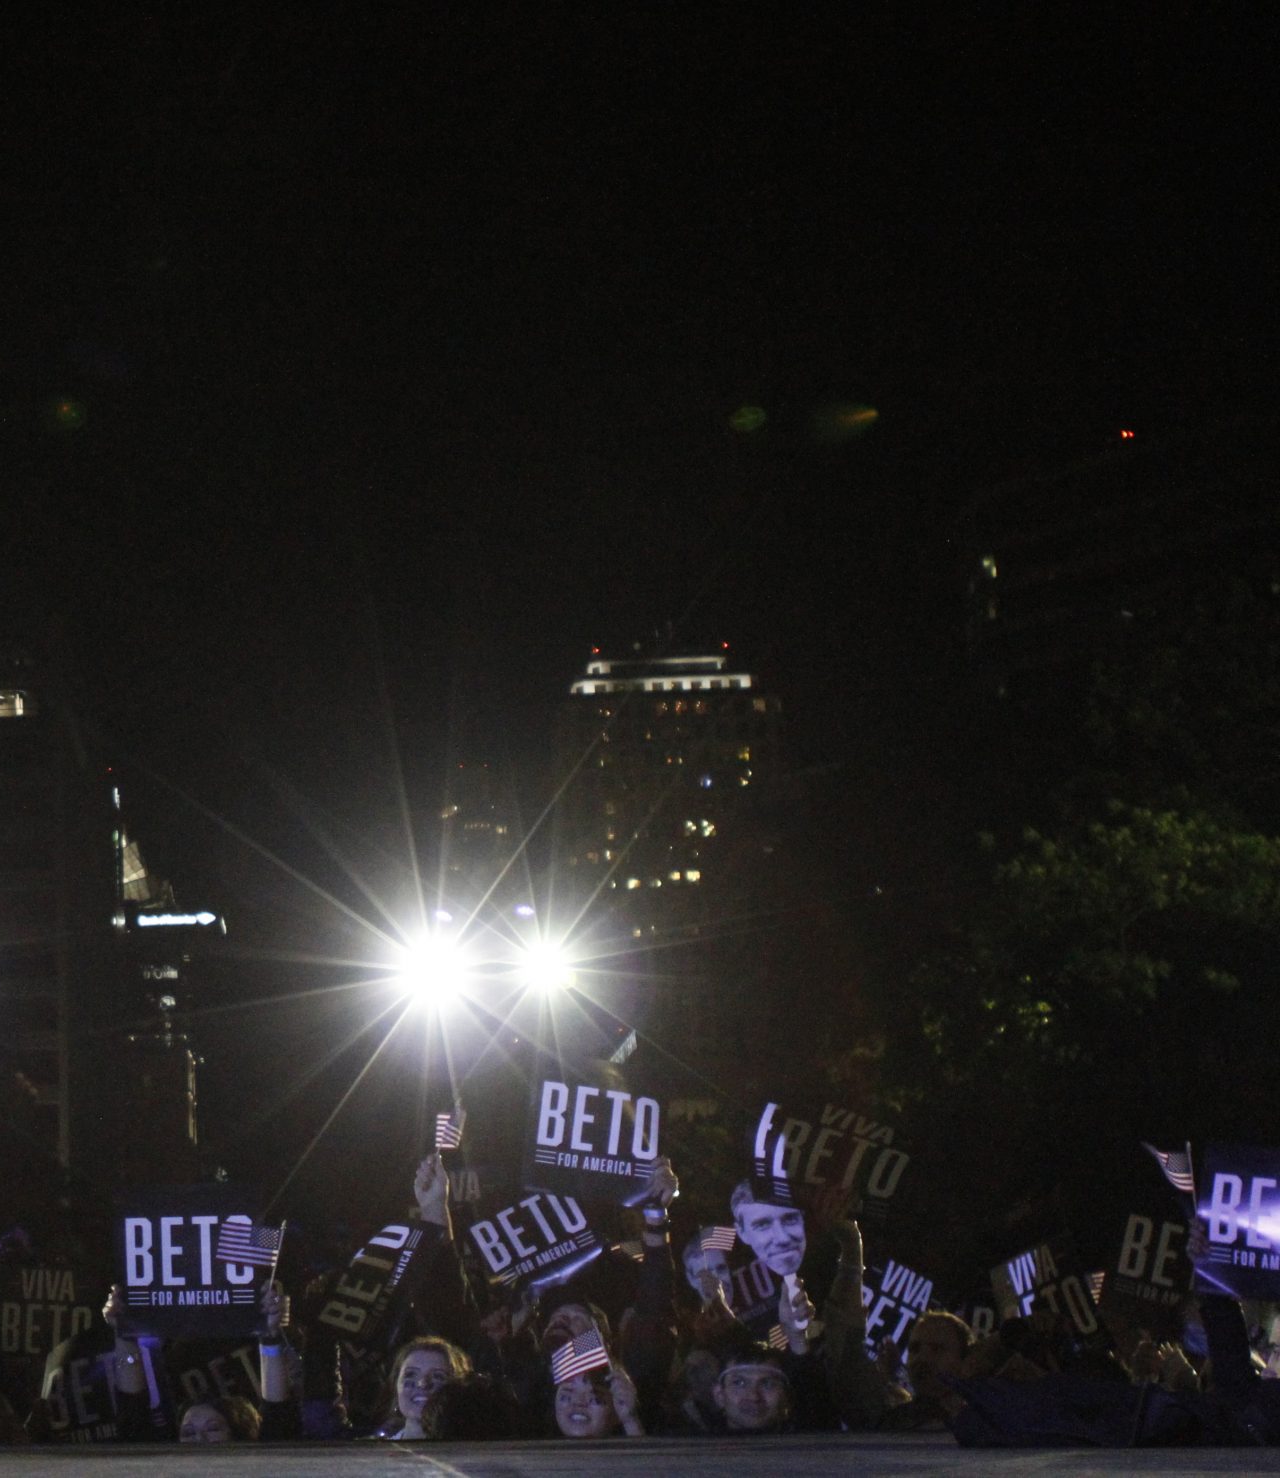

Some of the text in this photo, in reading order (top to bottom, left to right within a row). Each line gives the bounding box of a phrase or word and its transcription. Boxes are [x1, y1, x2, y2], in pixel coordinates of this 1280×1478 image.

[536, 1080, 660, 1160] BETO
[821, 1103, 895, 1146] VIVA
[557, 1152, 632, 1176] FOR AMERICA
[515, 1239, 578, 1276] FOR AMERICA
[1233, 1249, 1256, 1268] FOR
[21, 1270, 75, 1301] VIVA
[152, 1289, 230, 1306] FOR AMERICA
[881, 1259, 933, 1312] VIVA
